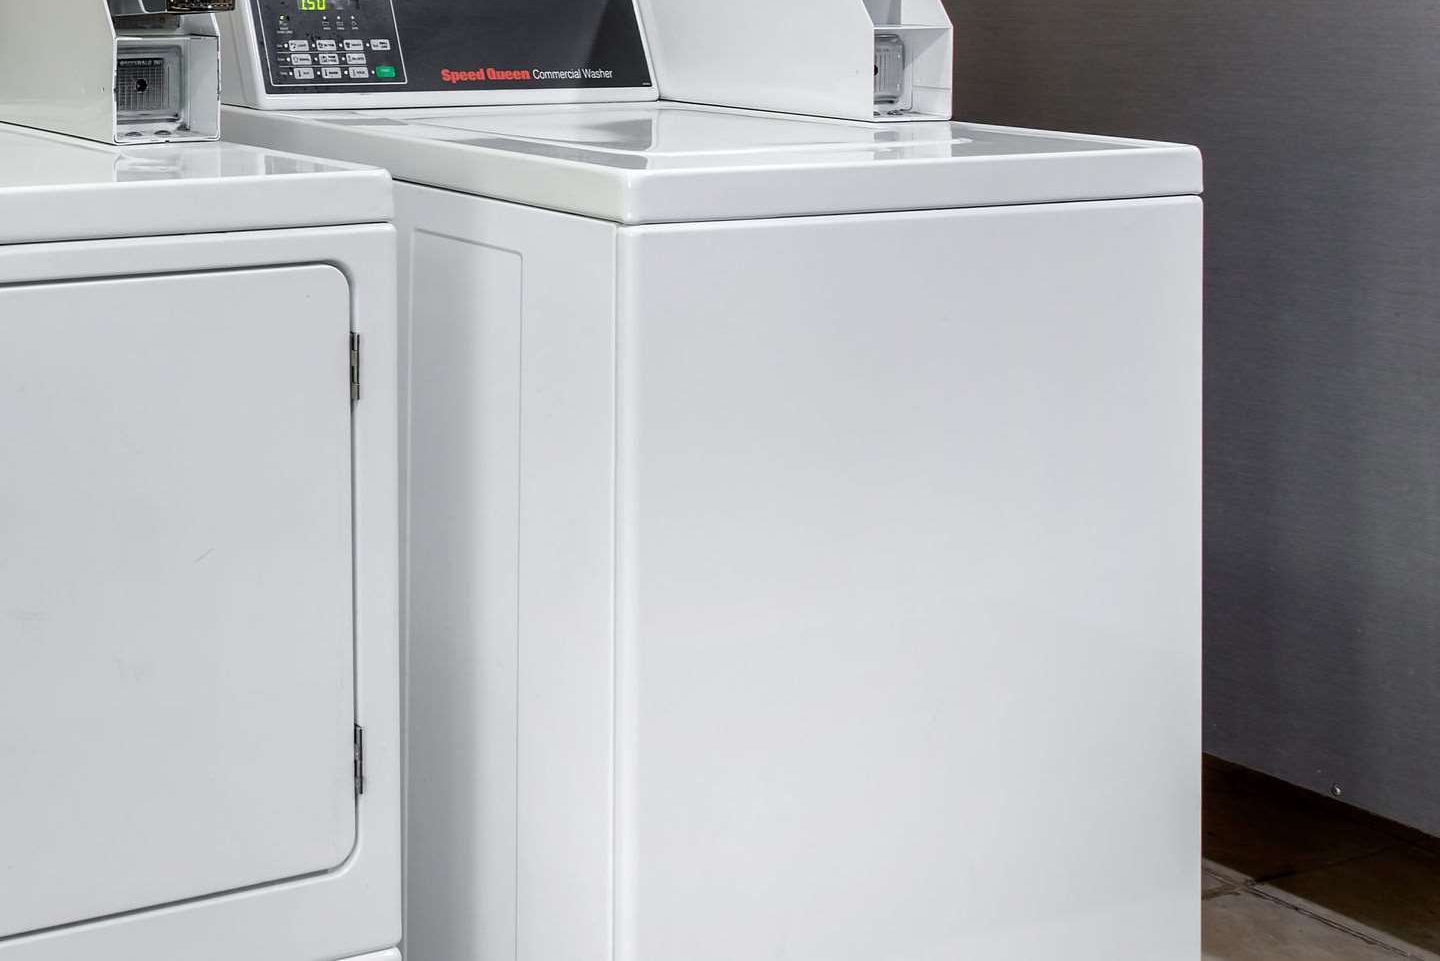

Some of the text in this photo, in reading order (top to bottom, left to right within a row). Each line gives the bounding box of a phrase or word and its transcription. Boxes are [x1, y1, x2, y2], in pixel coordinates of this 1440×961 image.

[441, 68, 613, 83] Speed Queen Commercial Washer
